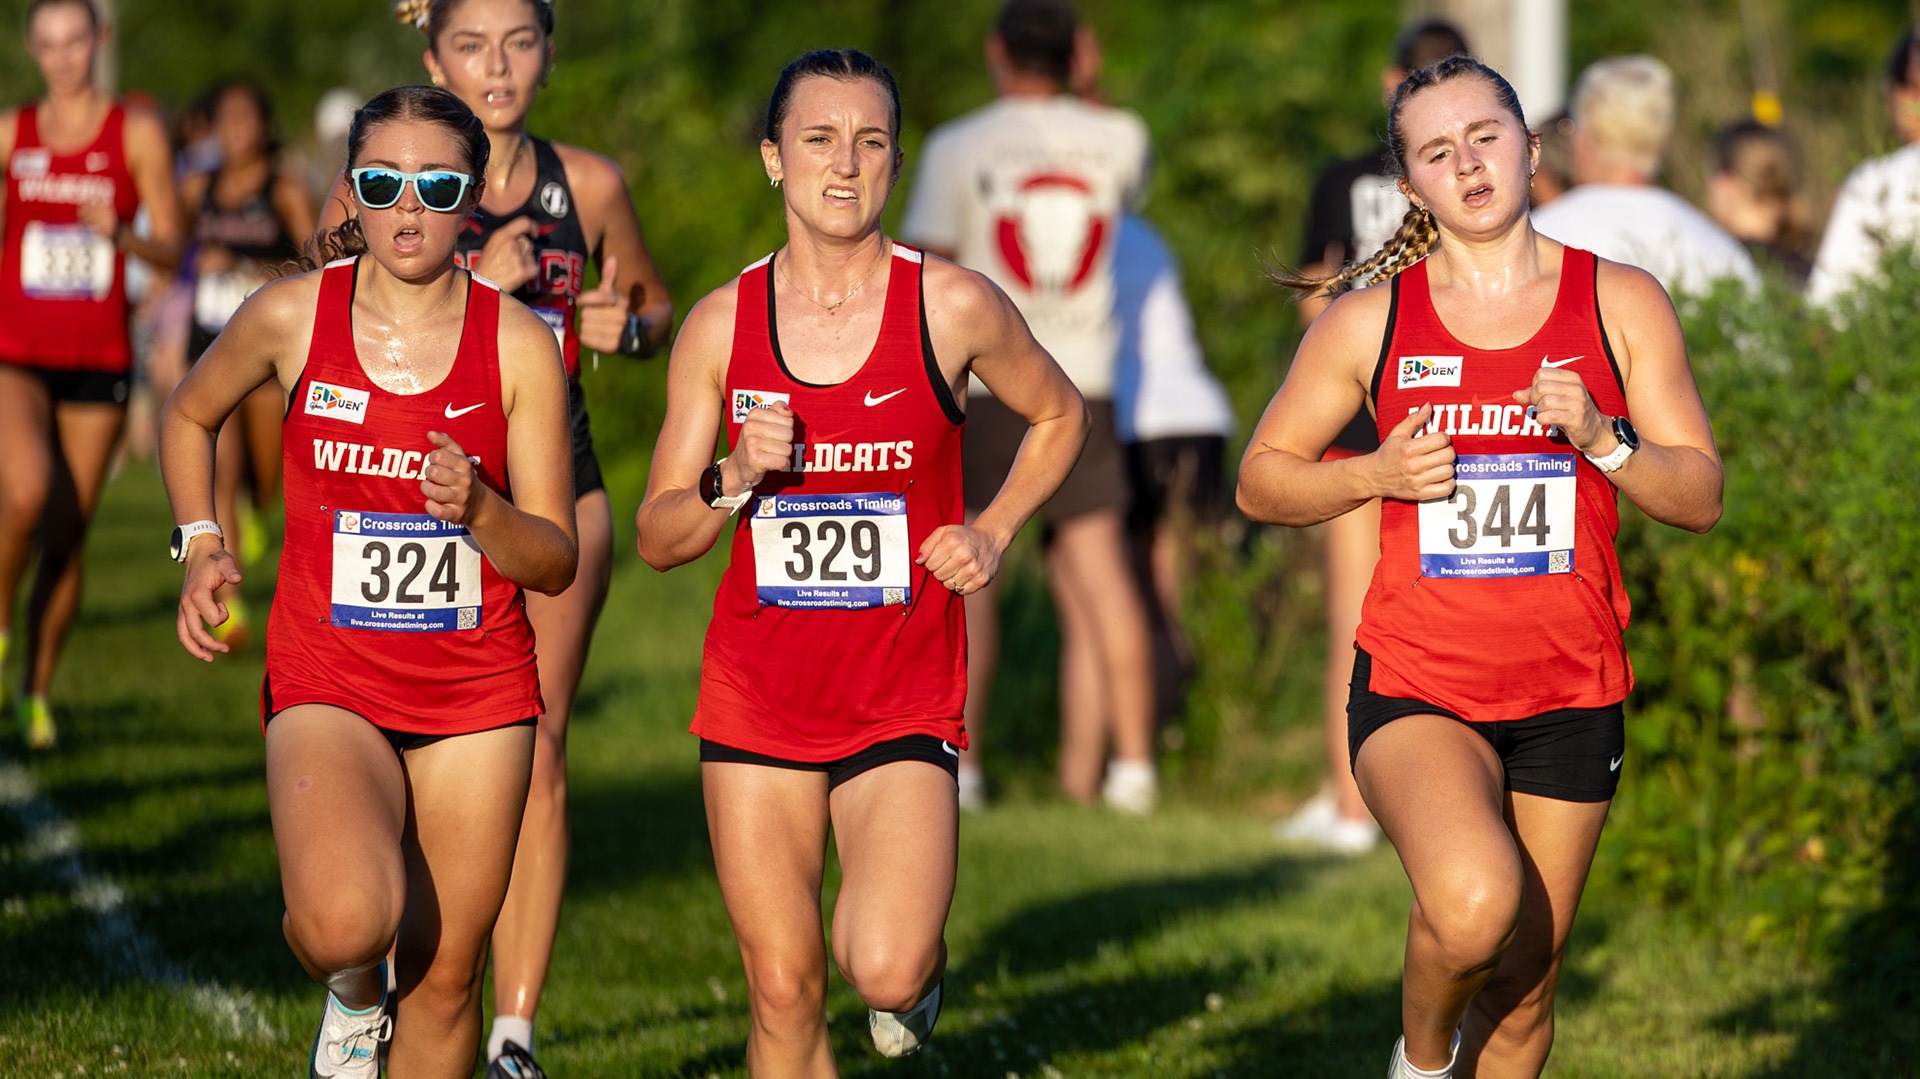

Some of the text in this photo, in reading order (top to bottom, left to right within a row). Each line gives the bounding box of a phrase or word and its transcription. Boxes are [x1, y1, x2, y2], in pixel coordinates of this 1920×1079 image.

[1408, 404, 1558, 438] WILDCA
[780, 440, 914, 473] LDCATS
[1453, 458, 1572, 473] rossroads Timing
[777, 497, 901, 512] Crossroads Timing
[362, 517, 437, 531] Crossroads
[1447, 484, 1550, 549] 344
[782, 519, 881, 582] 329
[1460, 557, 1476, 565] Live
[1478, 557, 1505, 565] Results
[361, 541, 460, 603] 324
[1440, 566, 1535, 575] live.crossroadstiming.com
[777, 599, 869, 608] live.crossroadstiming.com
[371, 611, 387, 619] Live
[388, 611, 416, 620] Results
[350, 619, 444, 630] live.crossroadstiming.com
